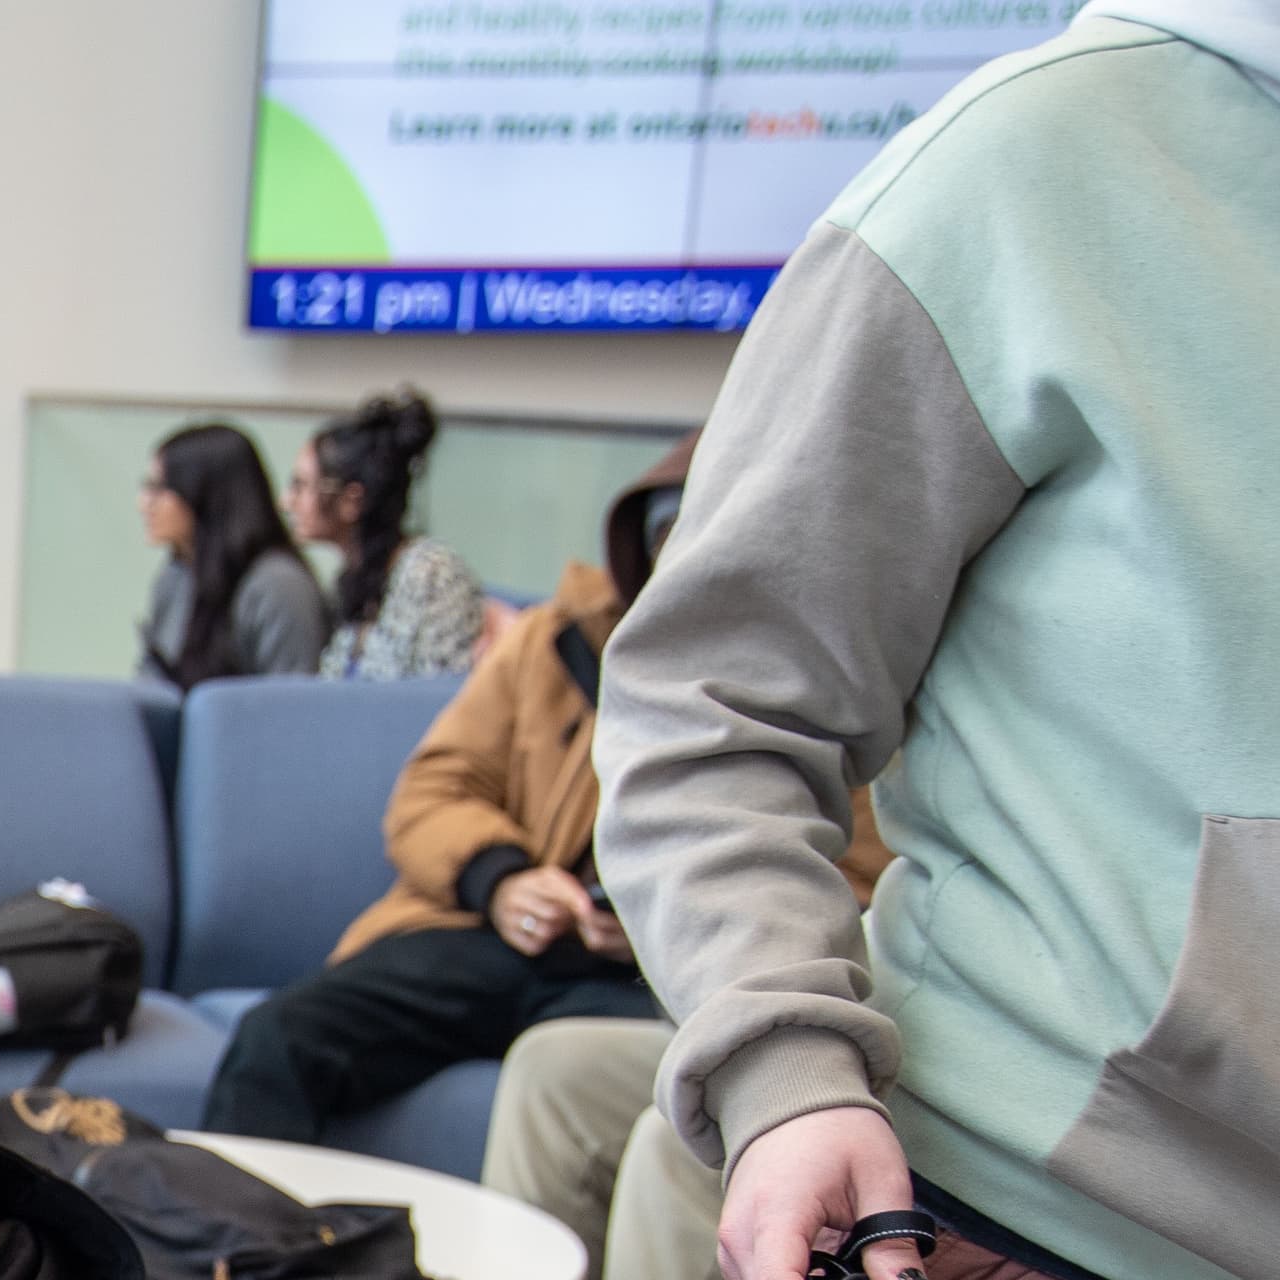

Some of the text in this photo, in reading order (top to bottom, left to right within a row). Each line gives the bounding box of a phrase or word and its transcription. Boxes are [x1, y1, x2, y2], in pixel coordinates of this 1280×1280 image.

[797, 5, 912, 31] various
[920, 0, 1048, 27] cultures
[389, 107, 481, 142] Learn
[491, 112, 575, 140] more
[585, 108, 618, 140] at
[270, 271, 366, 326] 1:21
[373, 281, 452, 334] pm
